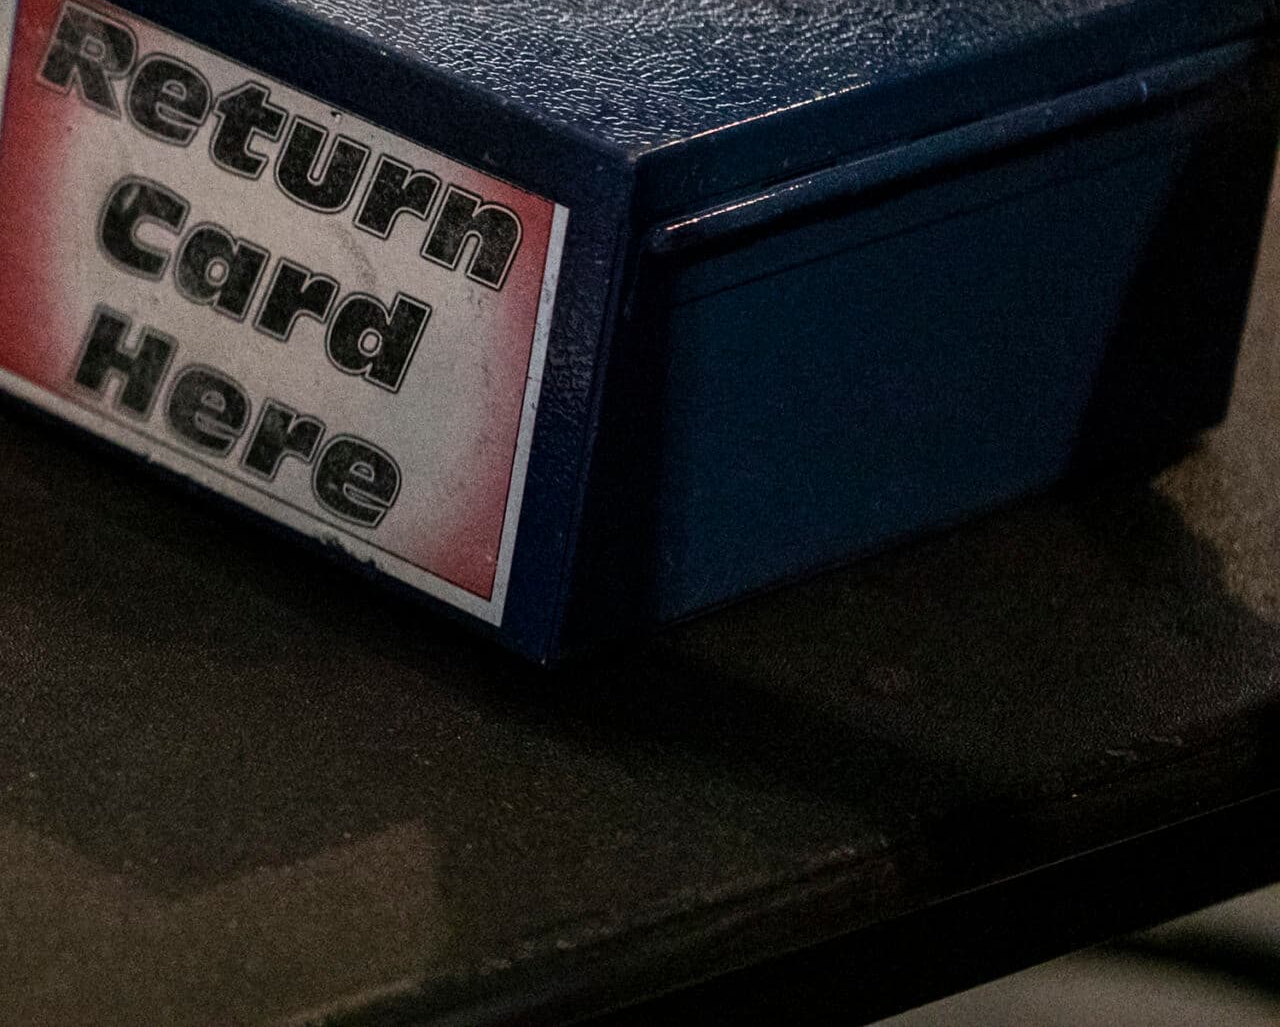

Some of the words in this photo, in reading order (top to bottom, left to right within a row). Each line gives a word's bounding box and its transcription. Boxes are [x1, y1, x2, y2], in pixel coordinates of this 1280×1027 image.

[37, 0, 523, 292] Return
[96, 174, 432, 394] Card
[72, 303, 402, 530] Here
